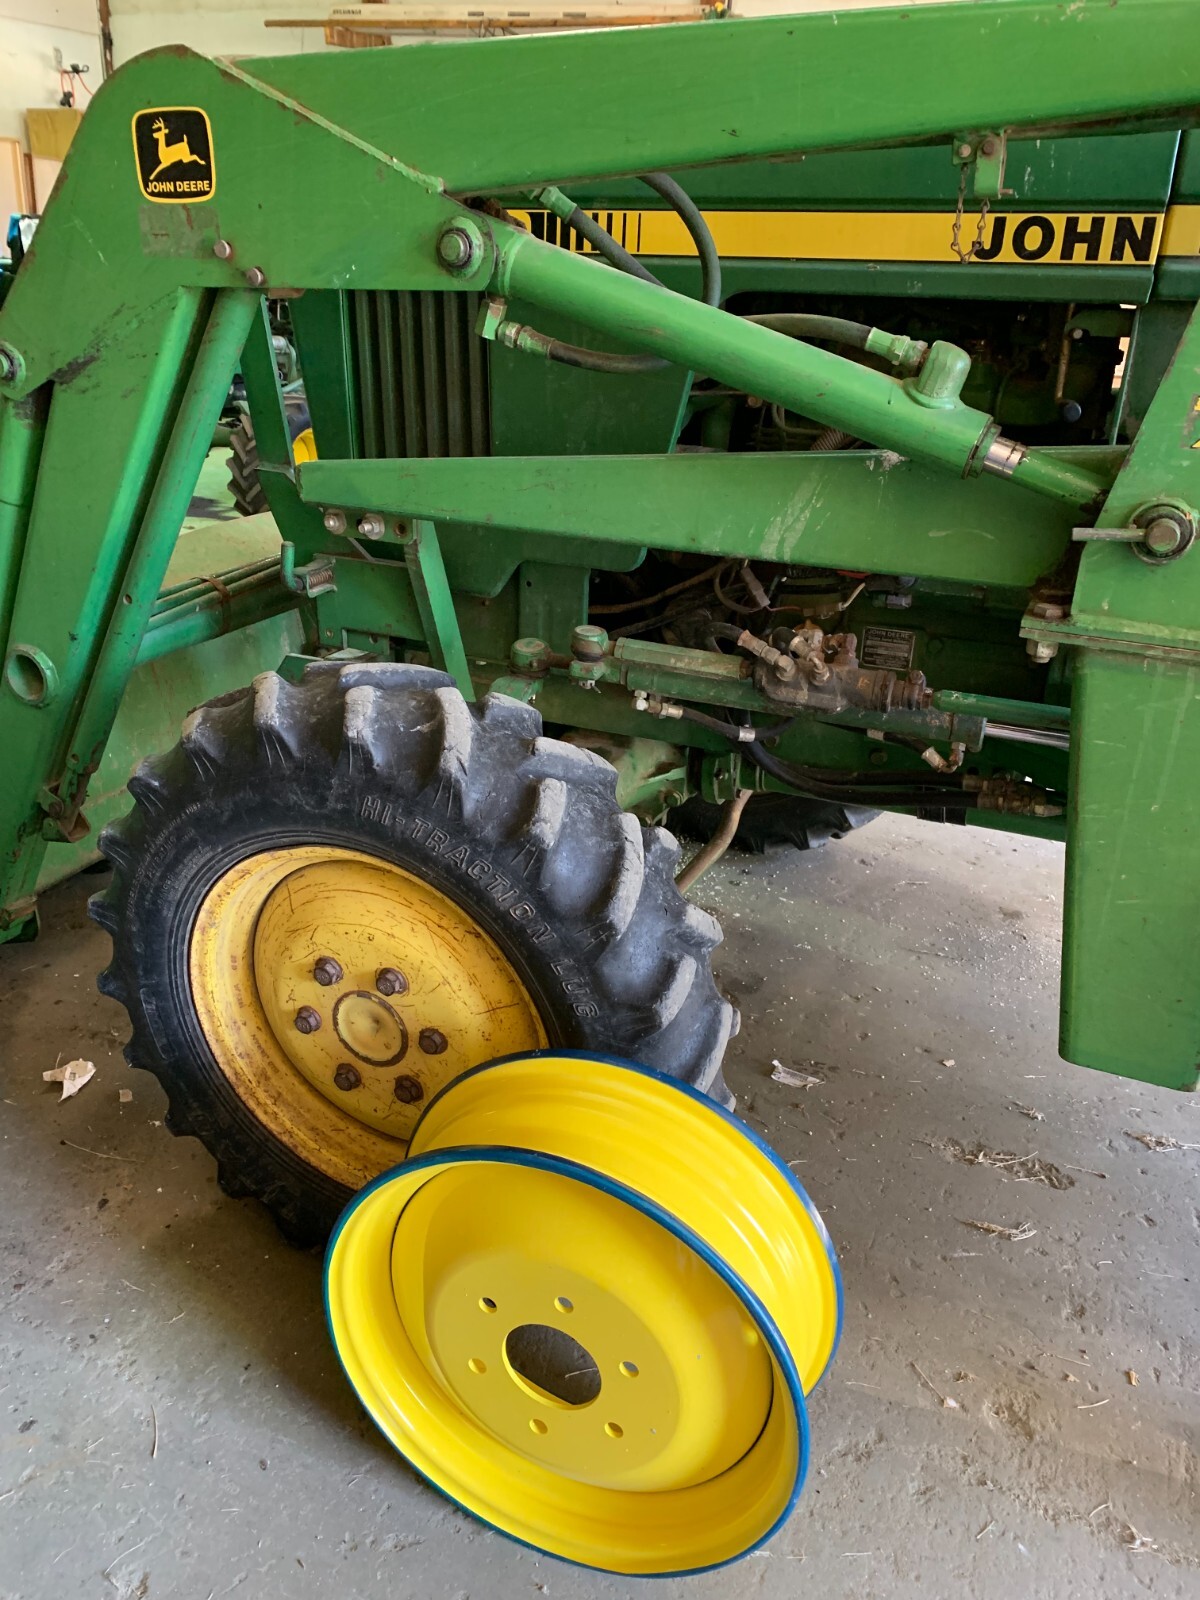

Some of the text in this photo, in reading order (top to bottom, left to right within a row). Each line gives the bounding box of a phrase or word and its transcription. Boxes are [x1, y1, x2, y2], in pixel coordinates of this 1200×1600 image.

[146, 180, 211, 193] JOHN DEERE
[972, 215, 1157, 262] JOHN
[550, 957, 600, 1018] LUG
